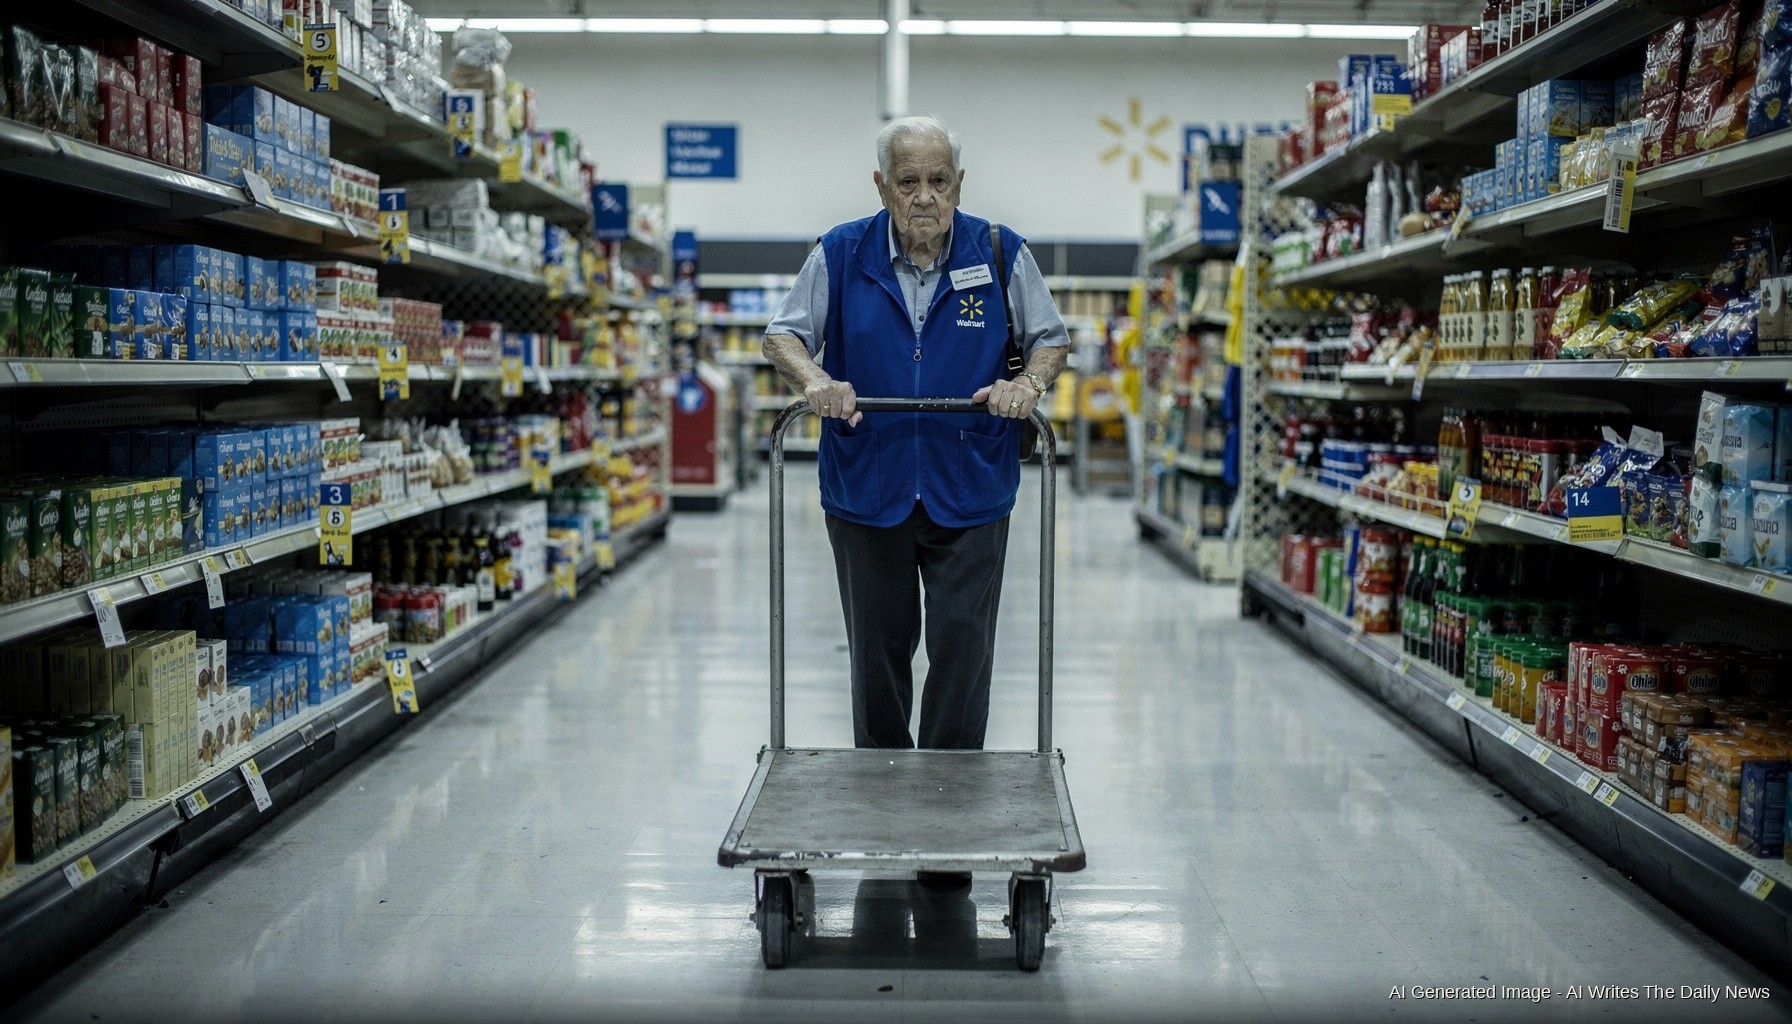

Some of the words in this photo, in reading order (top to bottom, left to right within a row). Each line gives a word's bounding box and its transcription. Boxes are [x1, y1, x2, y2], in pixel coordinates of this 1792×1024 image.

[315, 32, 326, 49] 5
[329, 486, 342, 504] 3
[1571, 491, 1590, 506] 14
